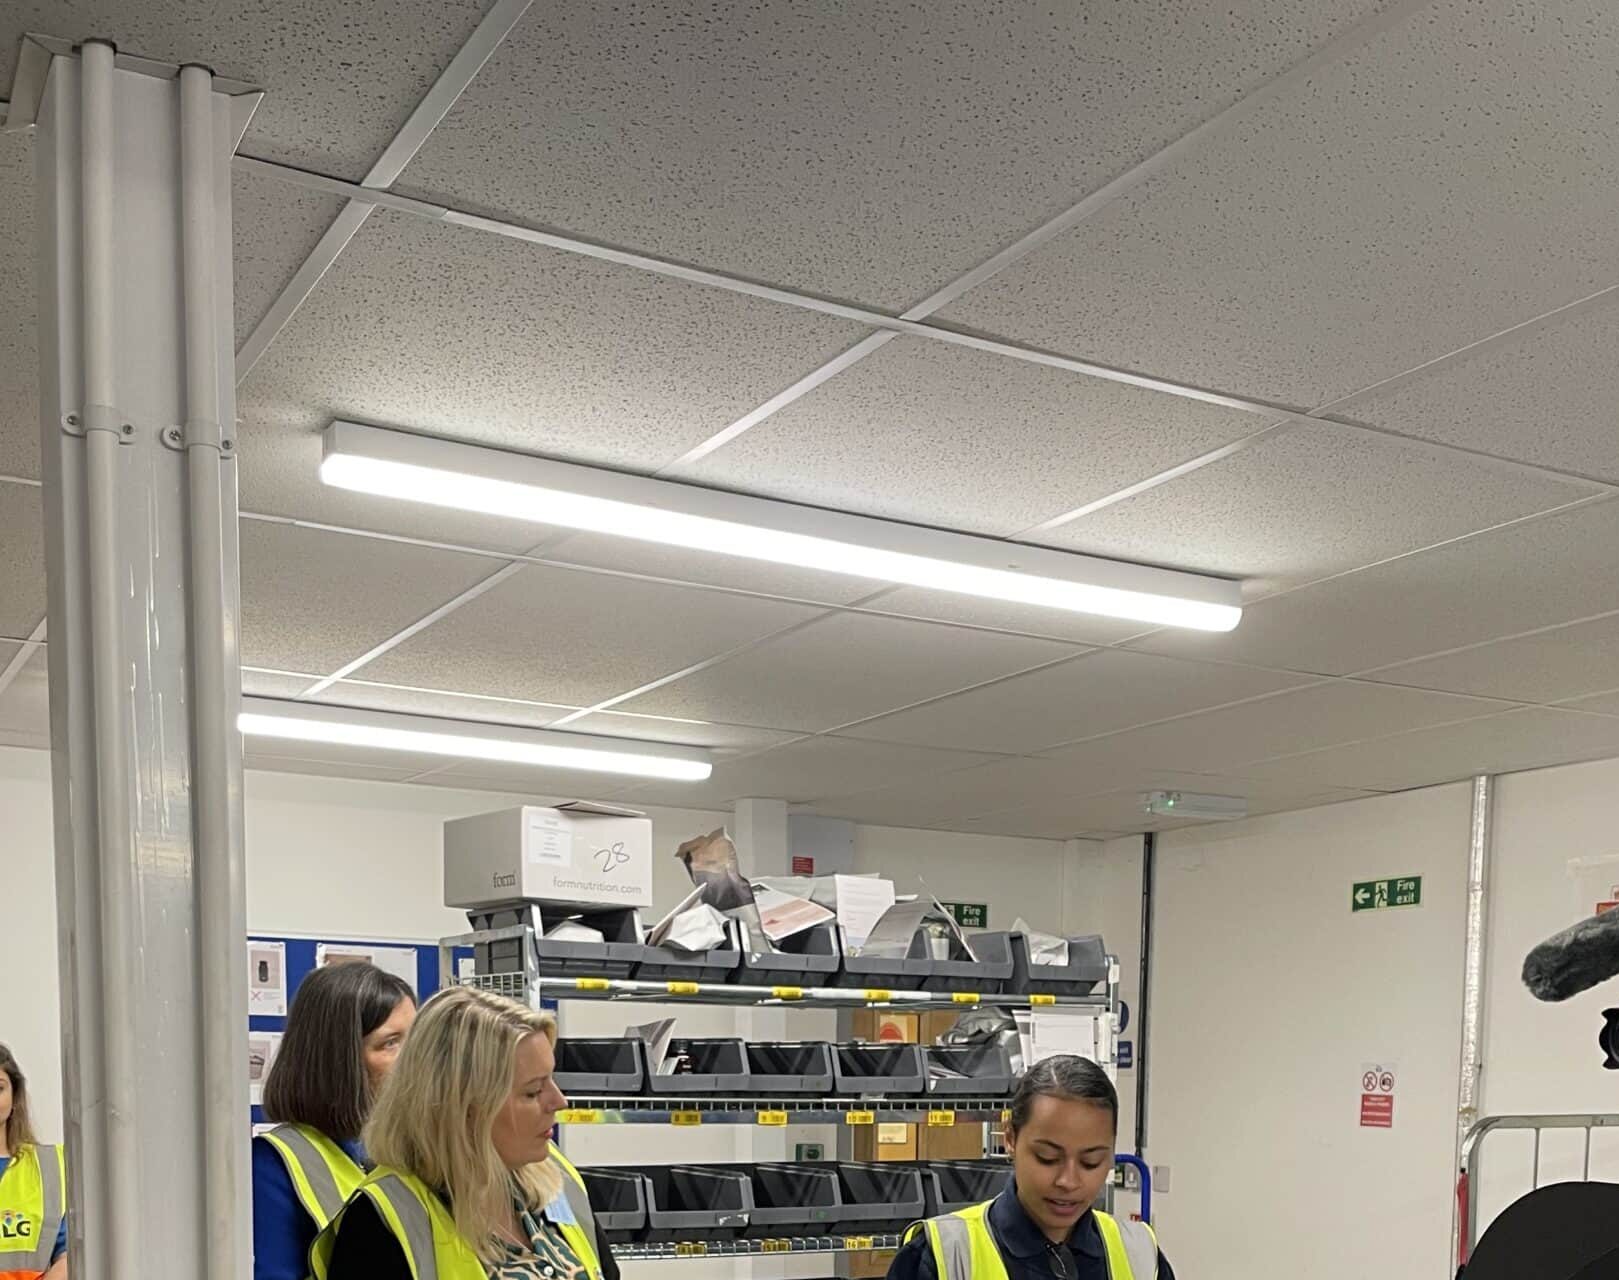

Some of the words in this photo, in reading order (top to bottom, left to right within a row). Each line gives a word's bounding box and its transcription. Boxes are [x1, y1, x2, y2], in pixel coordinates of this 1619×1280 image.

[594, 842, 630, 872] 28
[553, 877, 642, 894] formnutrition.com
[1397, 880, 1415, 892] Fire
[1396, 892, 1415, 904] exit
[963, 905, 982, 916] Fire
[963, 916, 980, 926] exit
